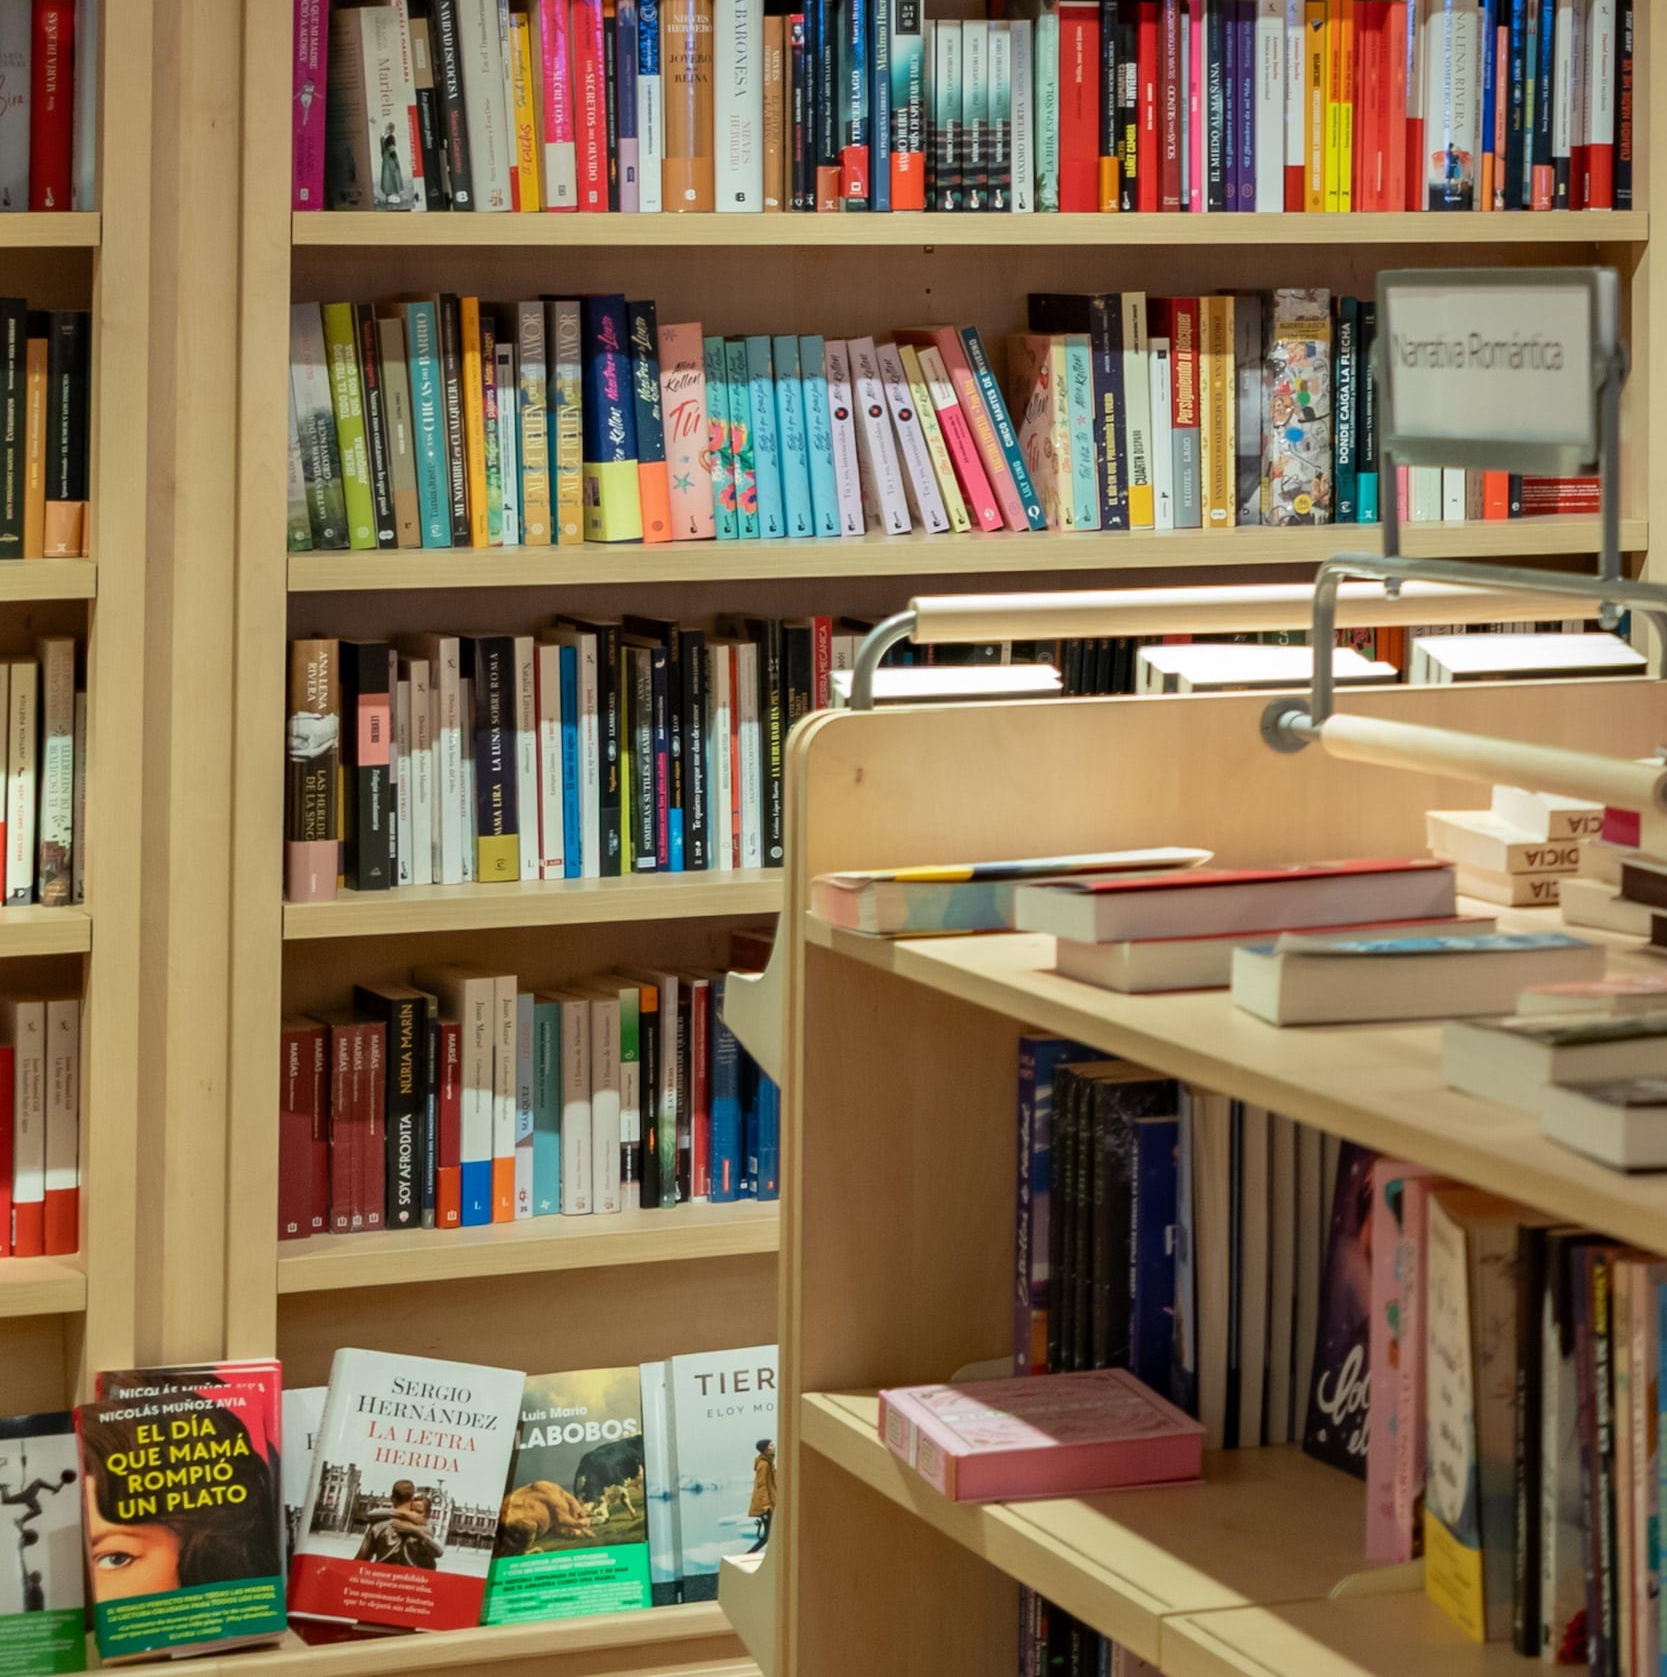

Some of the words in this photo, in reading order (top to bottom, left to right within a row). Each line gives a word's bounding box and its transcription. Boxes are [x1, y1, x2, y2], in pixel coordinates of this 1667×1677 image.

[416, 312, 430, 367] BARRIO
[1340, 322, 1350, 365] FLECHA
[1392, 332, 1464, 370] Narrativa
[1467, 331, 1564, 371] Romántica
[1340, 367, 1349, 382] LA
[419, 380, 435, 432] CHICAS
[1340, 384, 1349, 420] CAIGA
[1183, 437, 1191, 463] LAGO
[1339, 422, 1349, 464] DONDE
[1182, 468, 1192, 507] MIGUEL
[318, 651, 328, 676] ANA
[307, 662, 317, 702] RIVERA
[318, 678, 328, 710] LENA
[401, 1004, 413, 1048] MARÍN
[400, 1051, 413, 1094] NÚRIA
[399, 1114, 412, 1178] AFRODITA
[399, 1180, 411, 1205] SOY
[391, 1377, 472, 1404] SERGIO
[99, 1402, 159, 1423] NICOLÁS
[162, 1400, 214, 1417] MUÑOZ
[216, 1397, 247, 1409] AVIA
[357, 1395, 500, 1431] HERNÁNDEZ
[522, 1409, 547, 1422] Luis
[550, 1405, 588, 1419] Mario
[707, 1405, 745, 1418] ELOY
[136, 1424, 165, 1444] EL
[171, 1414, 216, 1439] DÍA
[368, 1420, 397, 1441] LA
[405, 1427, 477, 1452] LETRA
[107, 1447, 162, 1475] QUE
[169, 1433, 250, 1463] MAMÁ
[373, 1447, 460, 1473] HERIDA
[128, 1458, 234, 1494] ROMPIÓ
[117, 1495, 157, 1519] UN
[167, 1484, 247, 1511] PLATO
